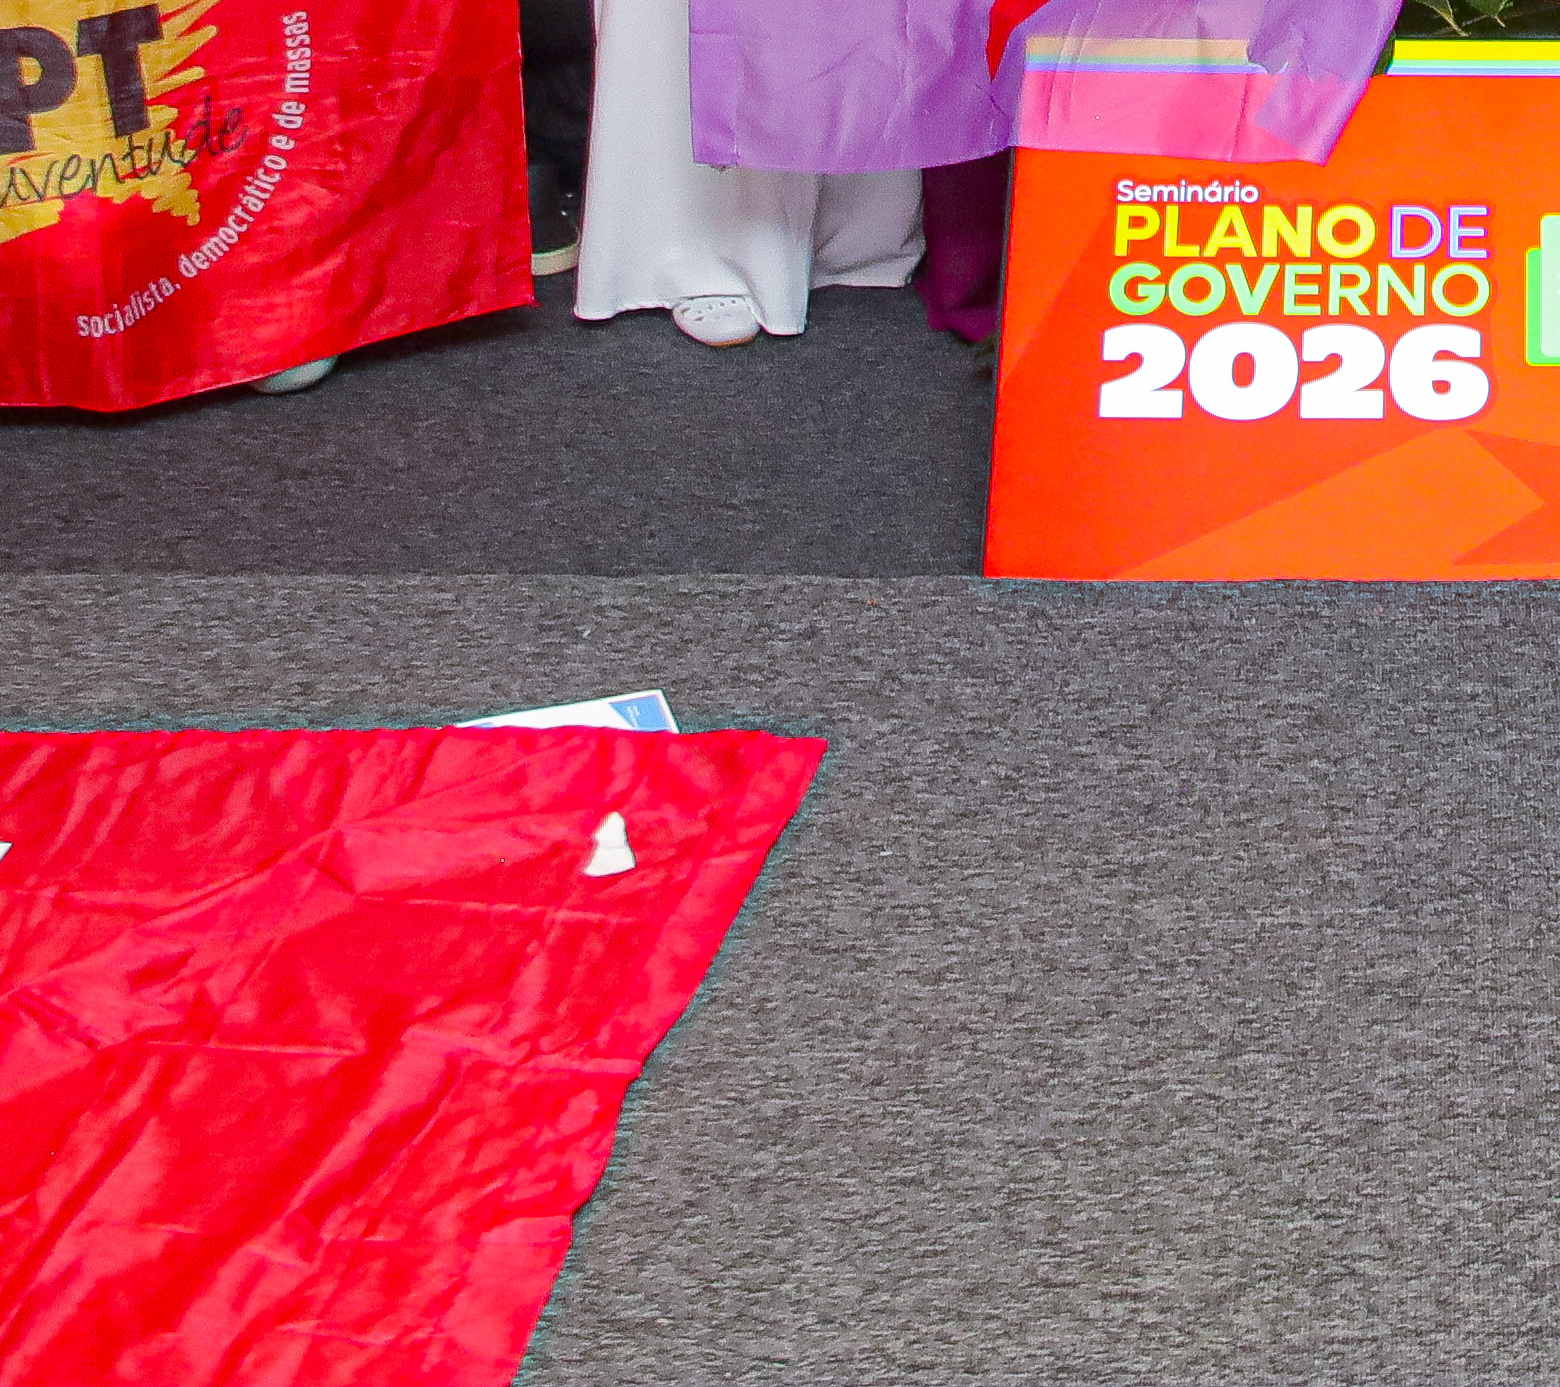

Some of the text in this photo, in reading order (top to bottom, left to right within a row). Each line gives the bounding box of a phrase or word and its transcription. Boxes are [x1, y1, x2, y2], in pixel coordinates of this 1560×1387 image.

[281, 10, 312, 94] massas
[271, 133, 296, 151] e
[272, 100, 306, 130] de
[178, 154, 289, 279] democrático
[1115, 179, 1259, 204] Seminário
[1113, 203, 1490, 259] PLANO DE
[1108, 261, 1491, 317] GOVERNO
[1098, 321, 1491, 422] 2026
